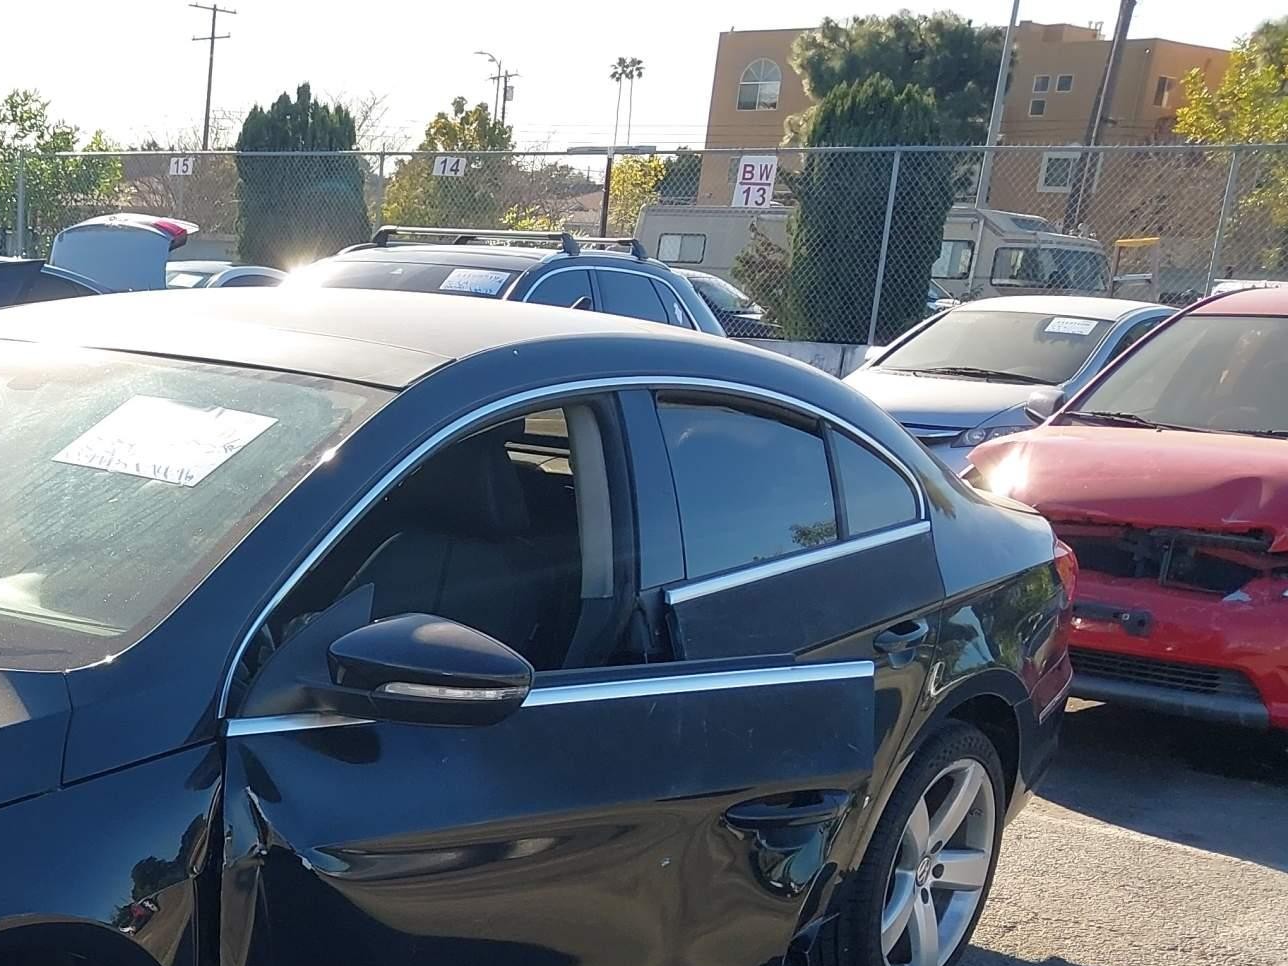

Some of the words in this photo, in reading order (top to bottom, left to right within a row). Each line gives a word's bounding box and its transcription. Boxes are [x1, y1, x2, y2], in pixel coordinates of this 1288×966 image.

[174, 158, 189, 174] 15
[440, 158, 461, 175] 14
[742, 163, 774, 182] BW
[742, 186, 767, 206] 13
